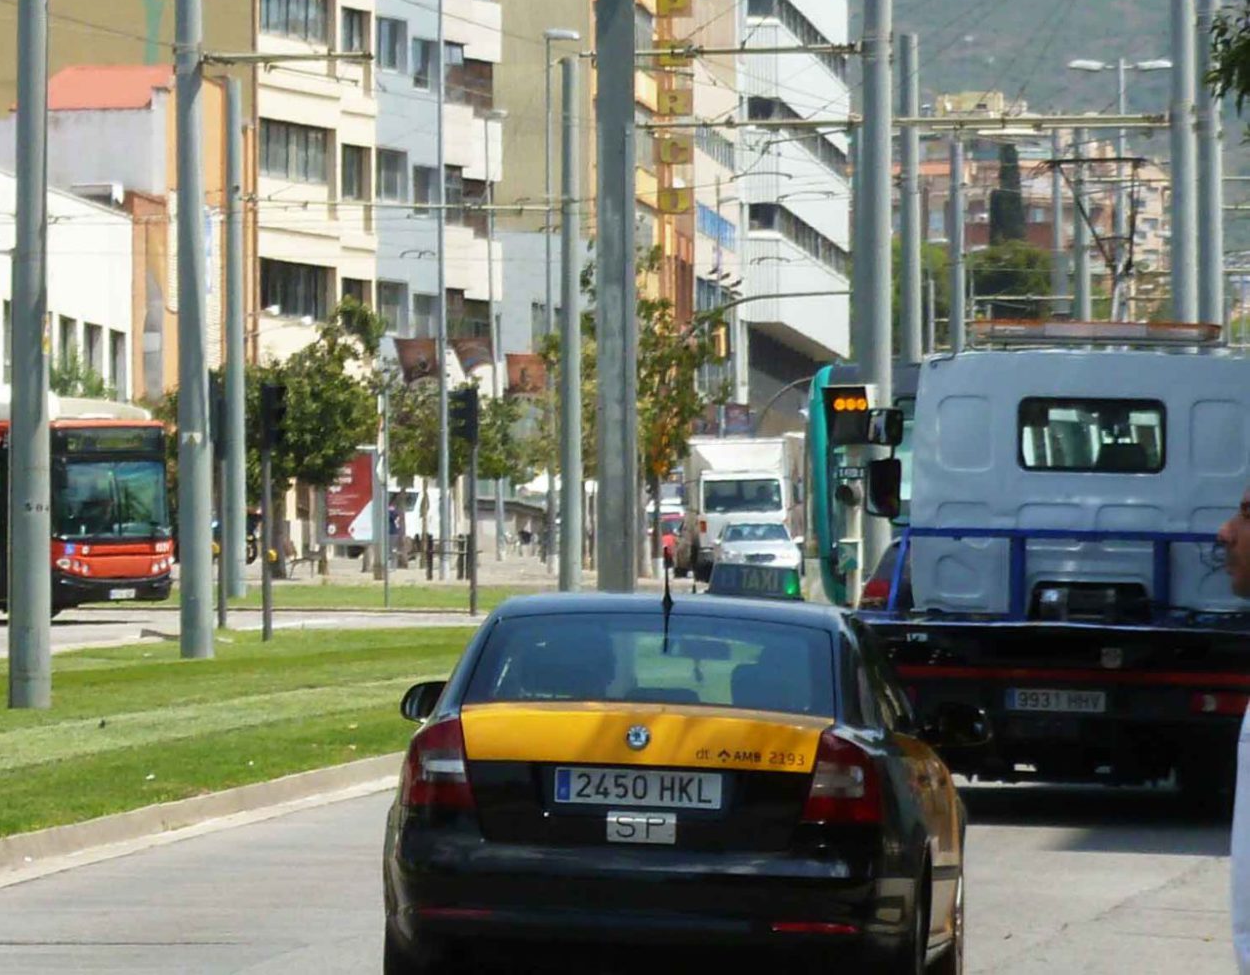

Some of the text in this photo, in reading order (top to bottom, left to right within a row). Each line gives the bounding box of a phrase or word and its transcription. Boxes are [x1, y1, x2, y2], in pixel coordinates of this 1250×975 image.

[734, 753, 805, 766] AMB 2193
[576, 773, 712, 804] 2450 HKL
[616, 816, 666, 839] SP
